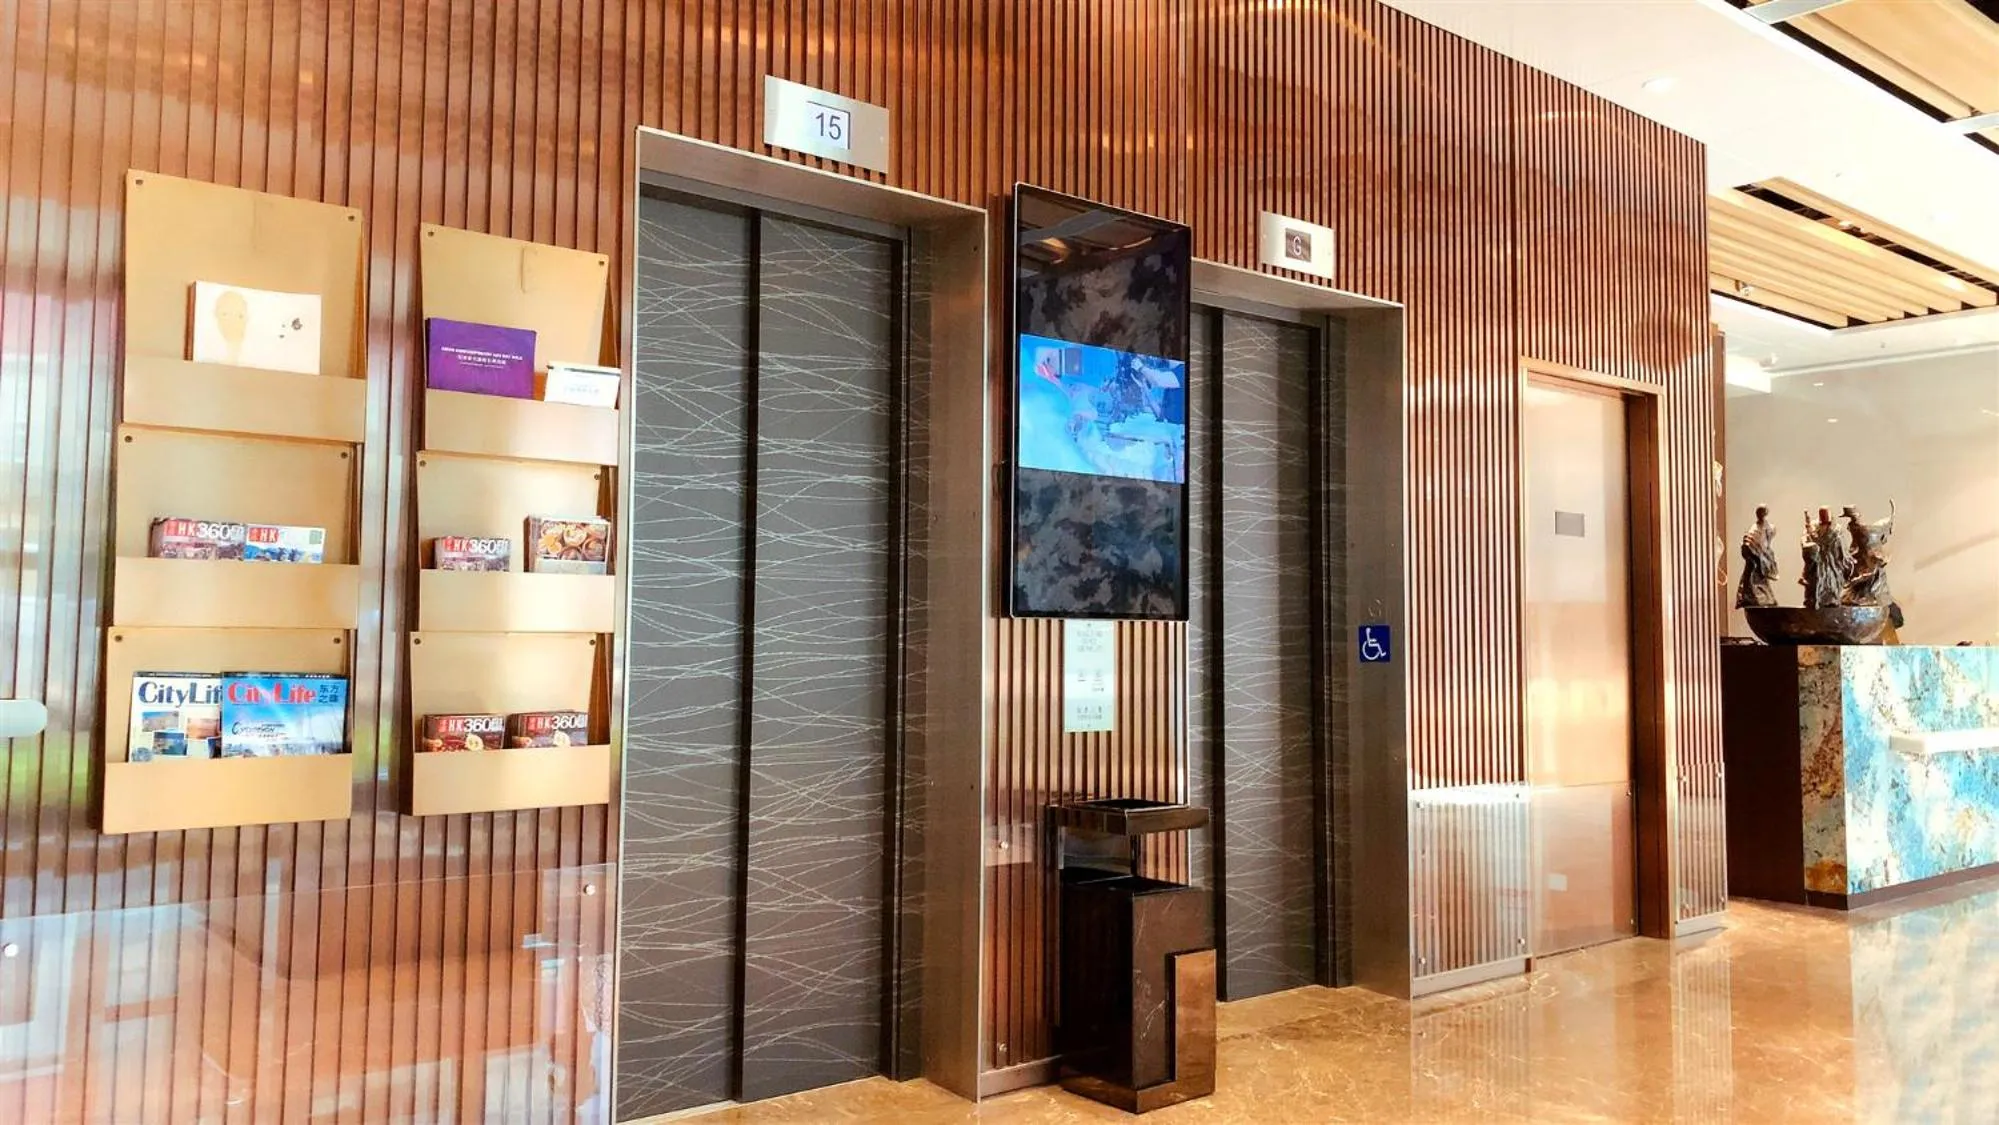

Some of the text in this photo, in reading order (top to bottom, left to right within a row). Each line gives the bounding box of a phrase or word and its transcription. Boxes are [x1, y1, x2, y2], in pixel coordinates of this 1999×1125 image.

[815, 111, 842, 141] 15
[1293, 235, 1302, 256] G
[138, 681, 222, 708] CityLif
